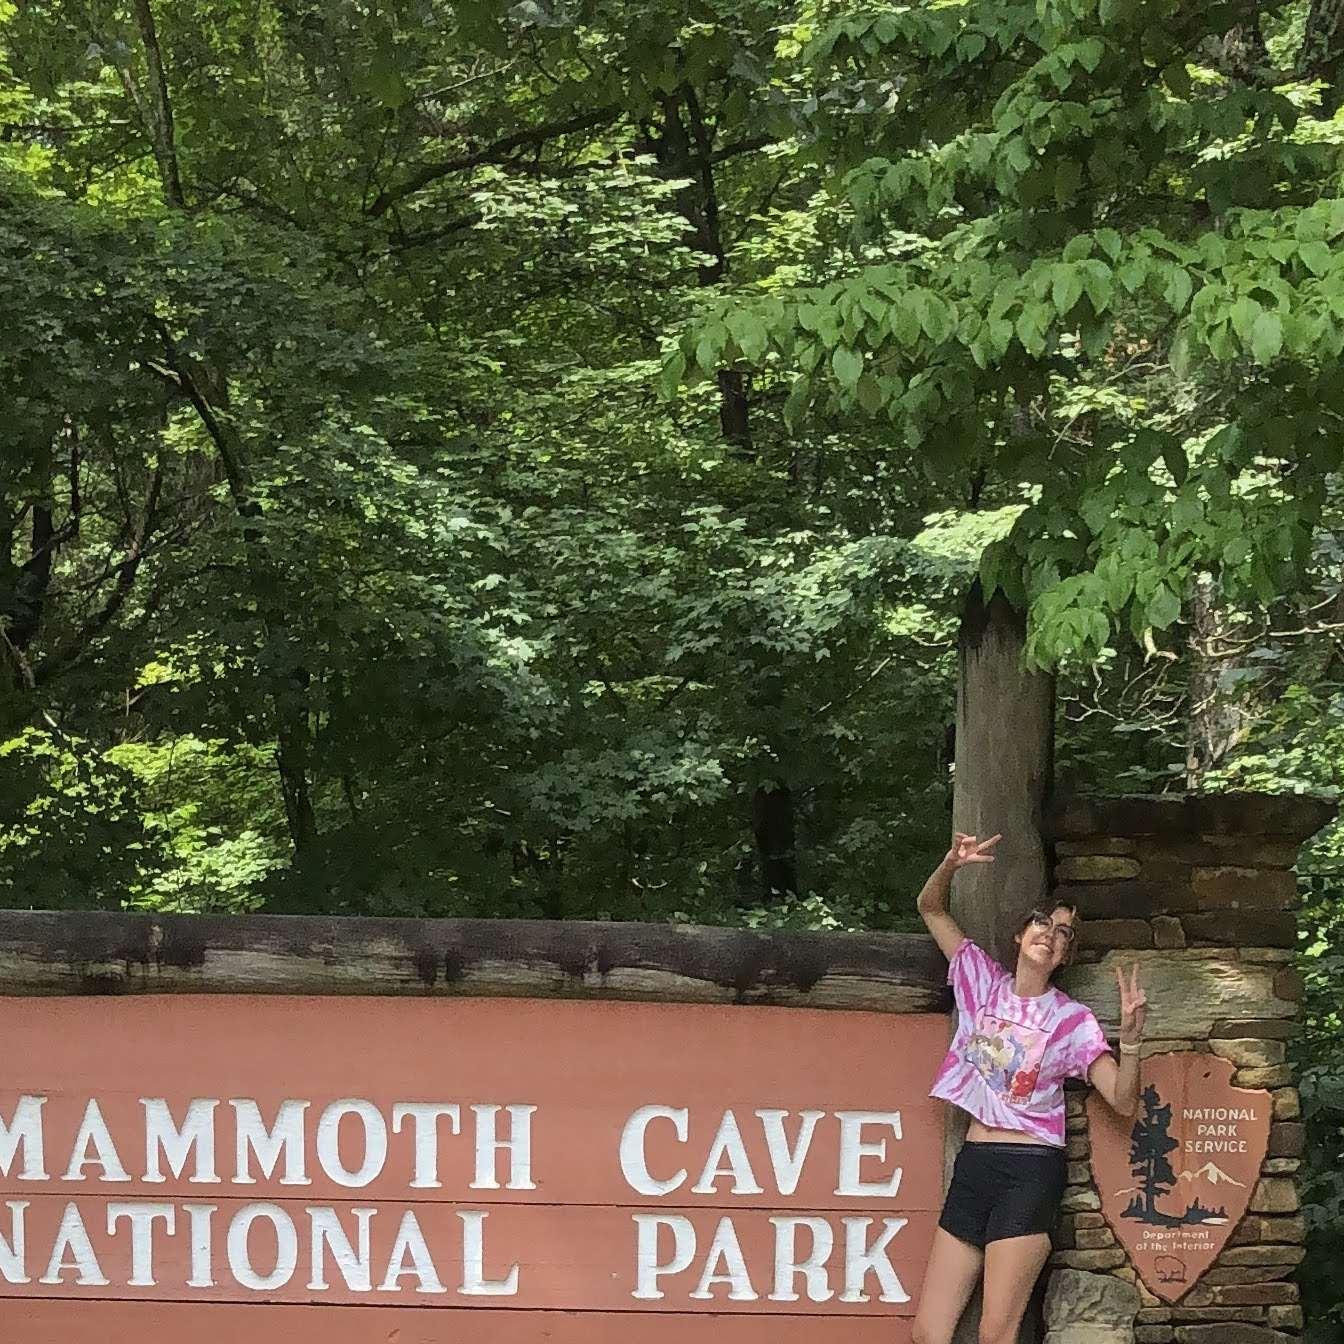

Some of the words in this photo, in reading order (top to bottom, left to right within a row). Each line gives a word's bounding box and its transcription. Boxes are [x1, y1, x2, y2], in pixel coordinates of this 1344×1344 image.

[1183, 1108, 1257, 1121] NATIONAL
[1197, 1124, 1238, 1137] PARK
[619, 1104, 903, 1197] CAVE
[1185, 1140, 1248, 1153] SERVICE
[1143, 1230, 1209, 1240] Department
[1151, 1242, 1168, 1251] the
[1172, 1242, 1216, 1250] Interior
[631, 1213, 912, 1303] PARK
